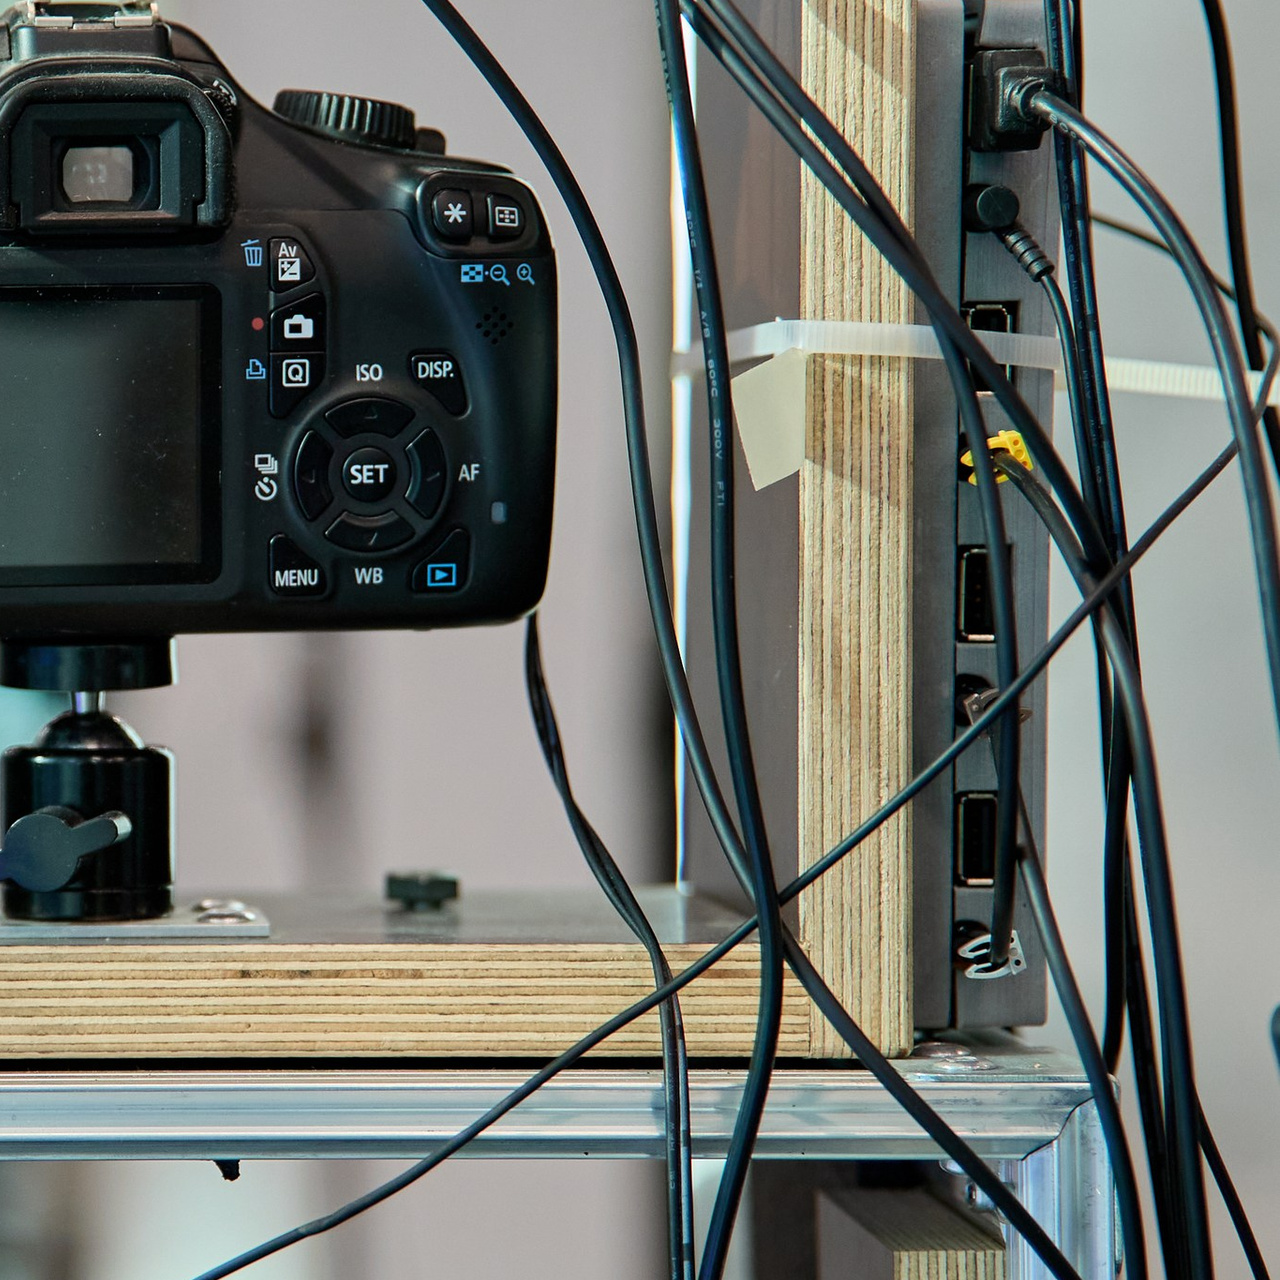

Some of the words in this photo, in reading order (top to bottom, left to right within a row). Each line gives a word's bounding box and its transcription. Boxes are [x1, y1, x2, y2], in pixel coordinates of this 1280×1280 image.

[278, 243, 300, 259] Av
[355, 364, 383, 382] ISO
[417, 360, 455, 380] DISP.
[349, 464, 389, 485] SET
[458, 463, 481, 481] AF
[275, 569, 319, 588] MENU
[354, 568, 384, 585] WB
